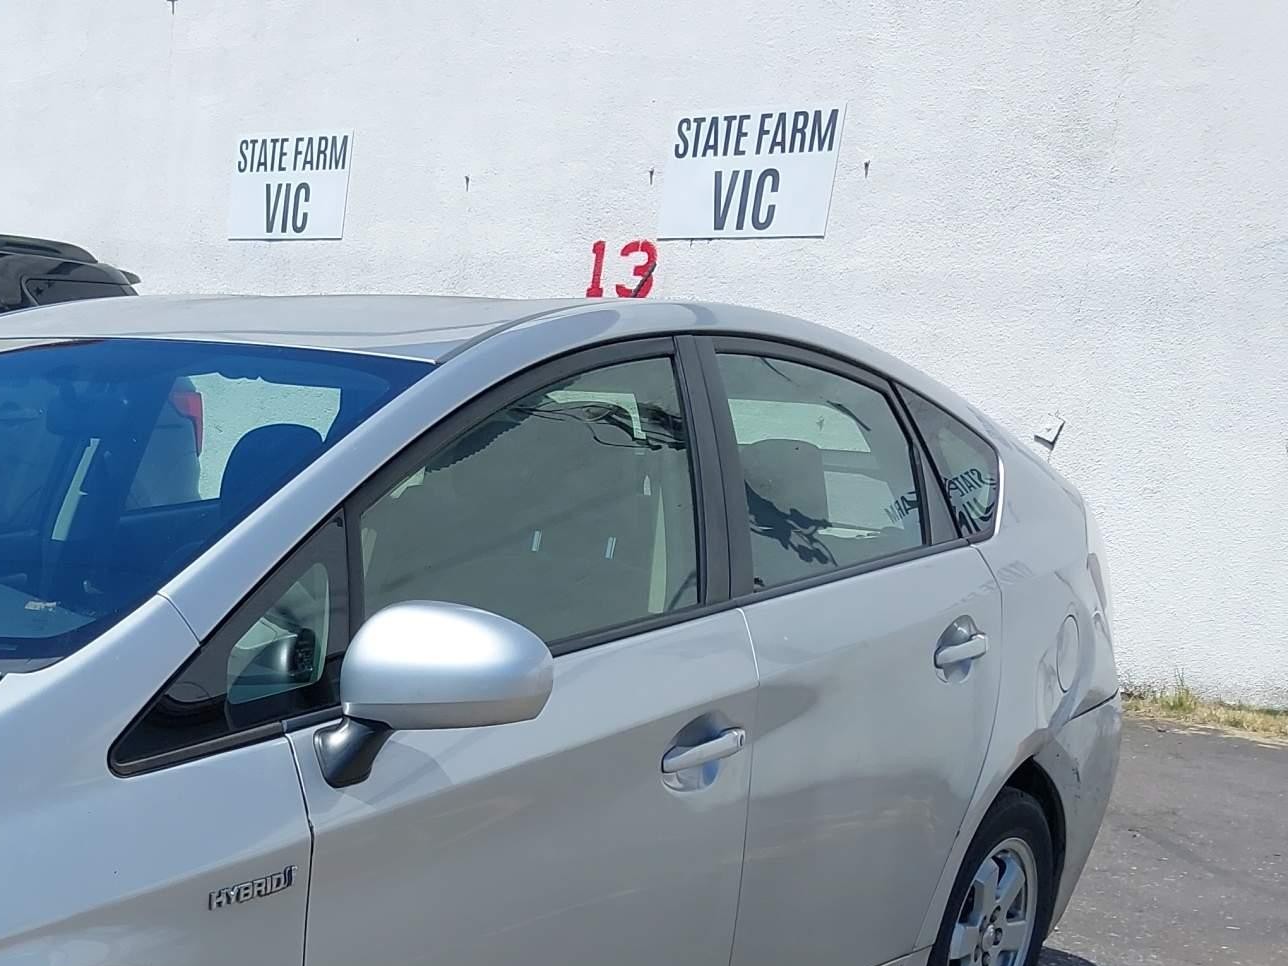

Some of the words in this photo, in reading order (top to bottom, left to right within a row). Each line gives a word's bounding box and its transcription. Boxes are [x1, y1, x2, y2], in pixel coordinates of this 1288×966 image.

[237, 138, 289, 173] STATE
[293, 135, 349, 171] FARM
[673, 114, 751, 159] STATE
[755, 108, 839, 155] FARM
[265, 183, 311, 234] VIC
[712, 168, 781, 231] VIC
[586, 240, 657, 299] 13
[208, 872, 290, 911] HYBRID
